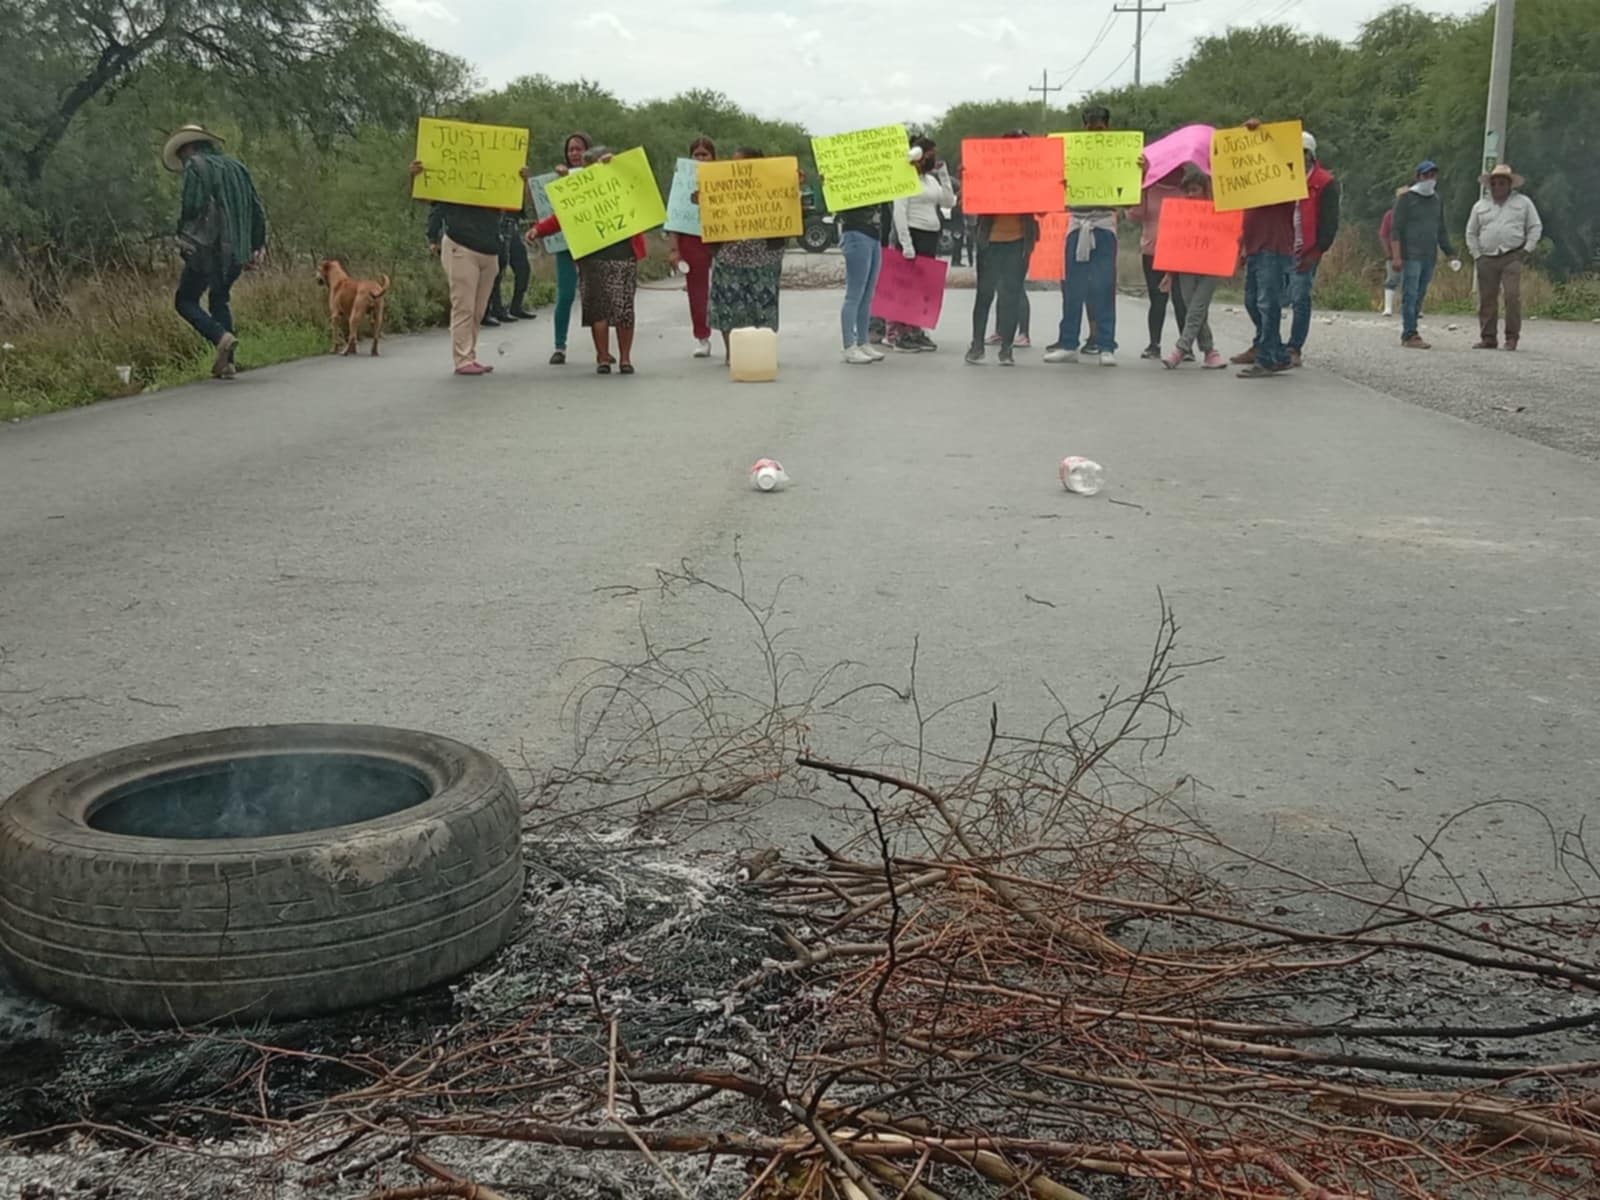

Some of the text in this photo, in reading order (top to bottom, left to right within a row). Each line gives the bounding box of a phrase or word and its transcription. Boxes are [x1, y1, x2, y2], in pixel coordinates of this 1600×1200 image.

[432, 126, 528, 151] JUSTICIA
[441, 149, 480, 167] PARA
[1231, 153, 1266, 168] PARA
[735, 201, 783, 217] JUSTICIA
[573, 210, 592, 225] NO
